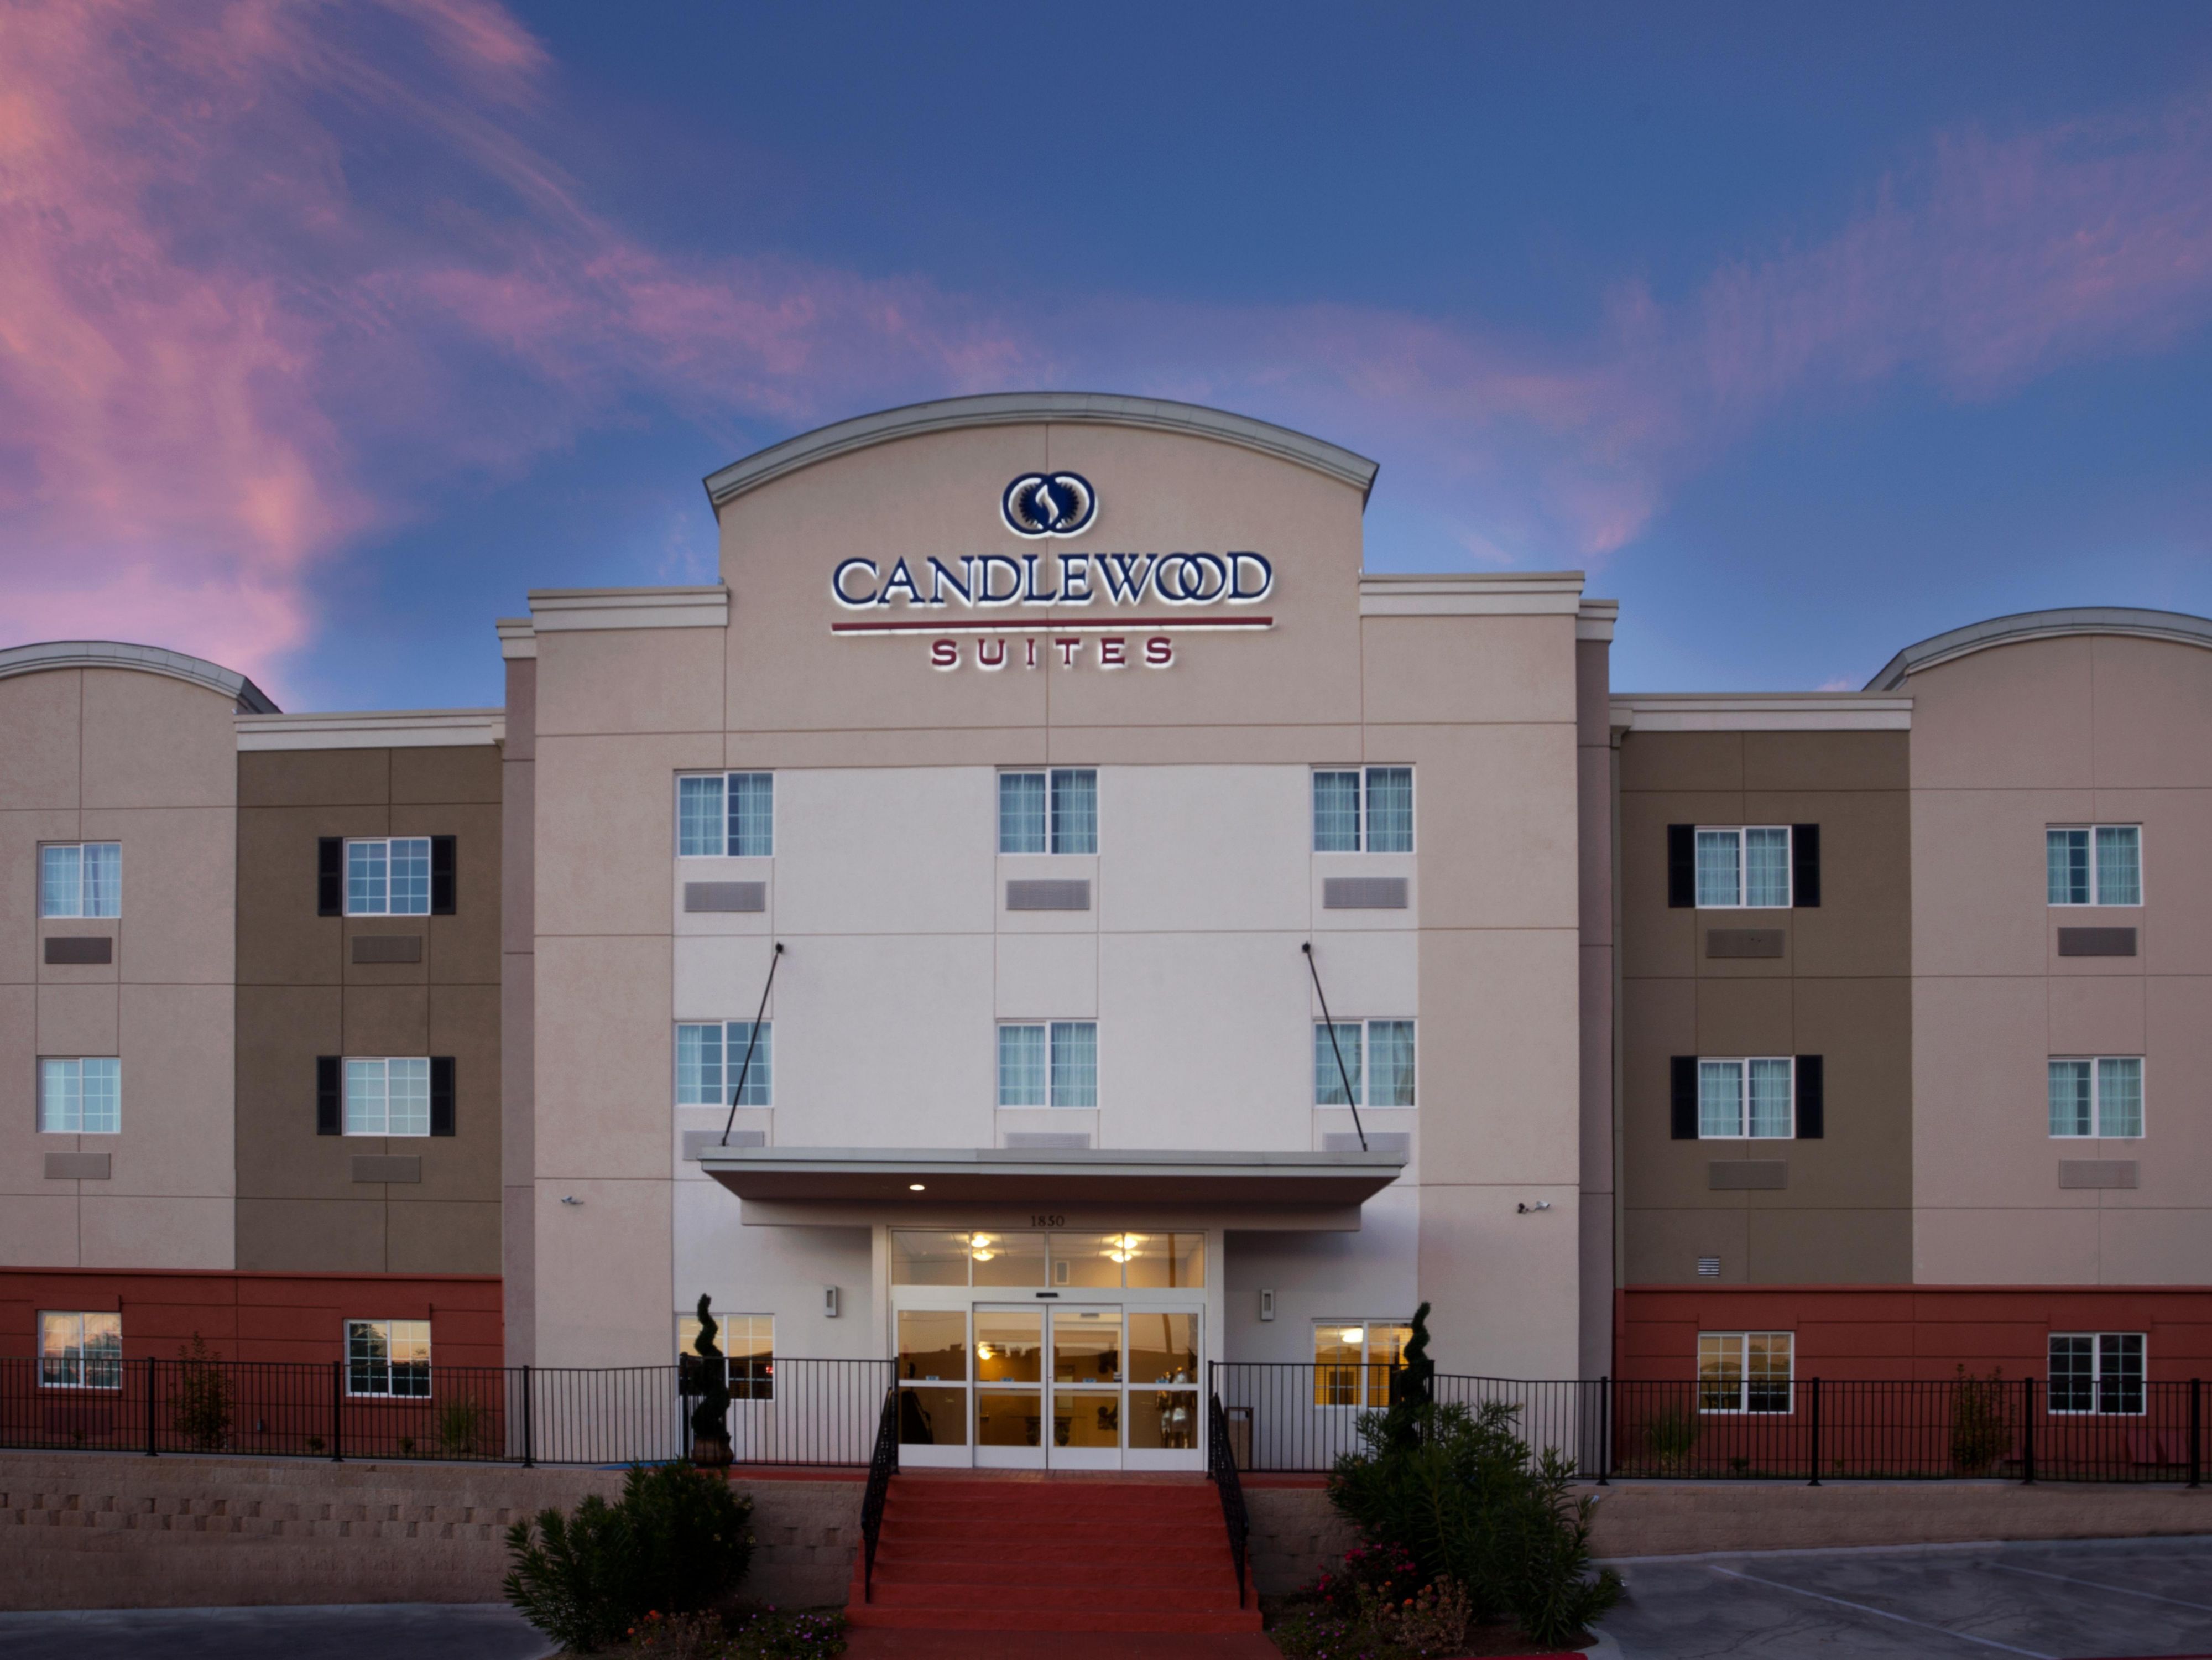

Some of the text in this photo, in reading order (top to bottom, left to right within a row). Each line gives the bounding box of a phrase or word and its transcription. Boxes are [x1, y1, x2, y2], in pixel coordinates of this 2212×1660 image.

[833, 551, 1272, 607] CANDLEWOOD
[931, 637, 1172, 667] SUITES
[1031, 1215, 1065, 1227] 1850
